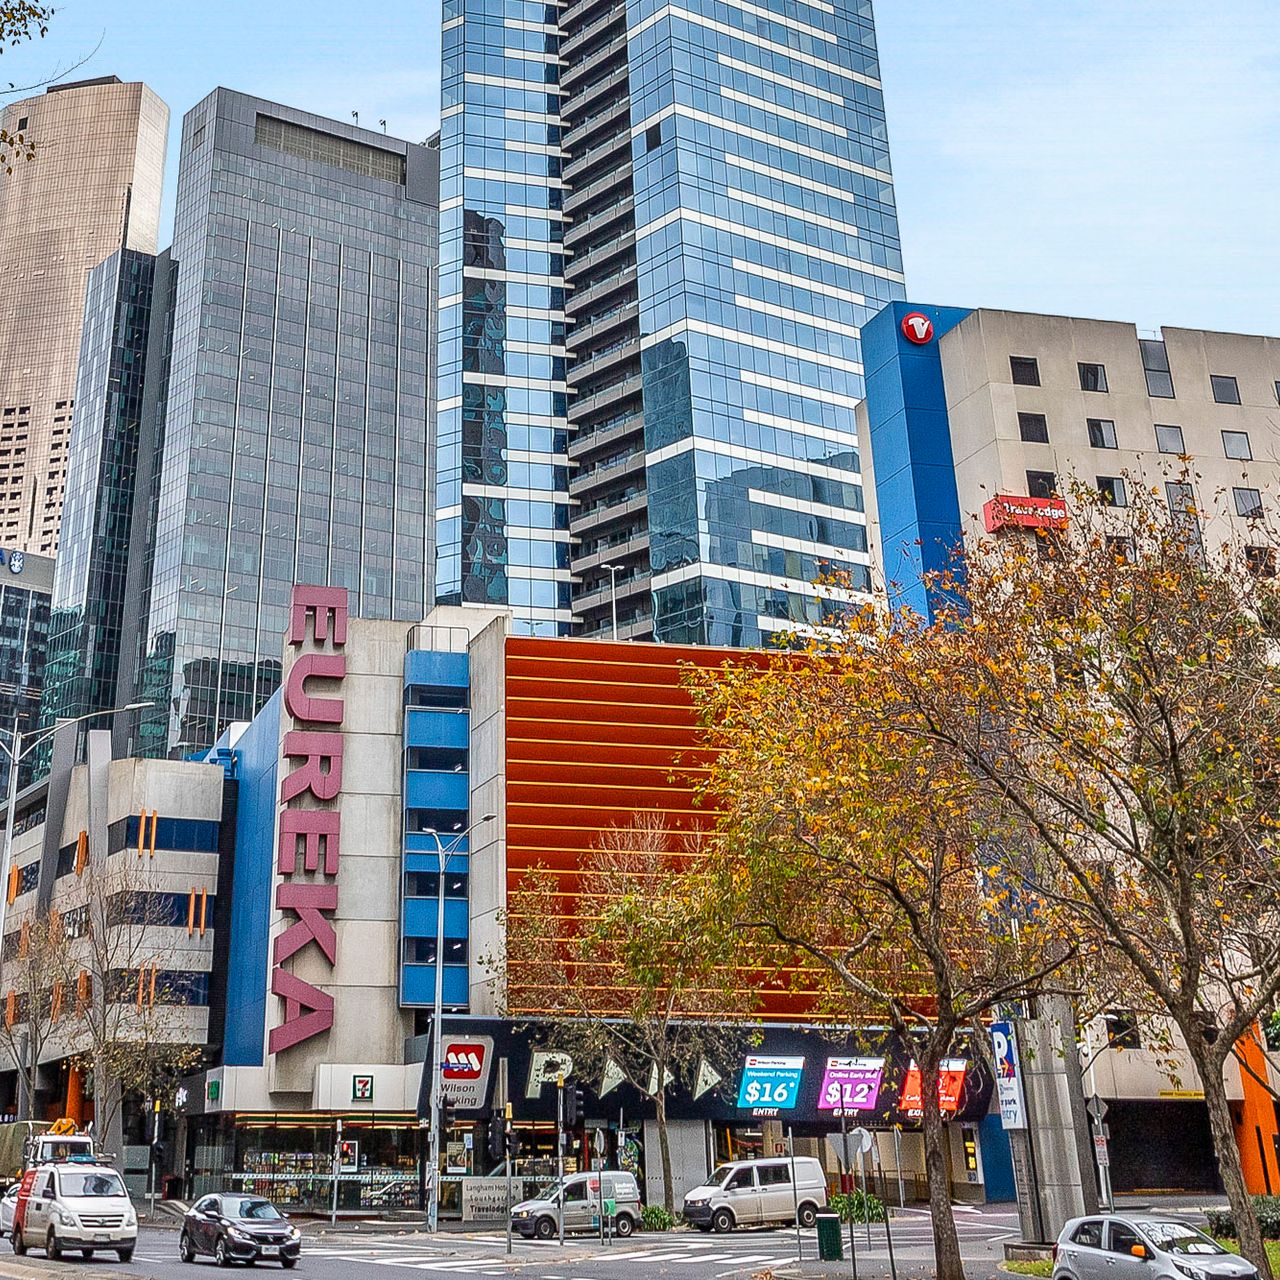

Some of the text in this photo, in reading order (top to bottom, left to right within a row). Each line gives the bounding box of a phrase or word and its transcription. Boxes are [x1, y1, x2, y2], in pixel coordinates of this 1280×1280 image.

[269, 584, 350, 1055] EUREKA
[440, 1083, 475, 1092] Wilson
[753, 1108, 779, 1116] ENTRY
[466, 1184, 494, 1193] Langham
